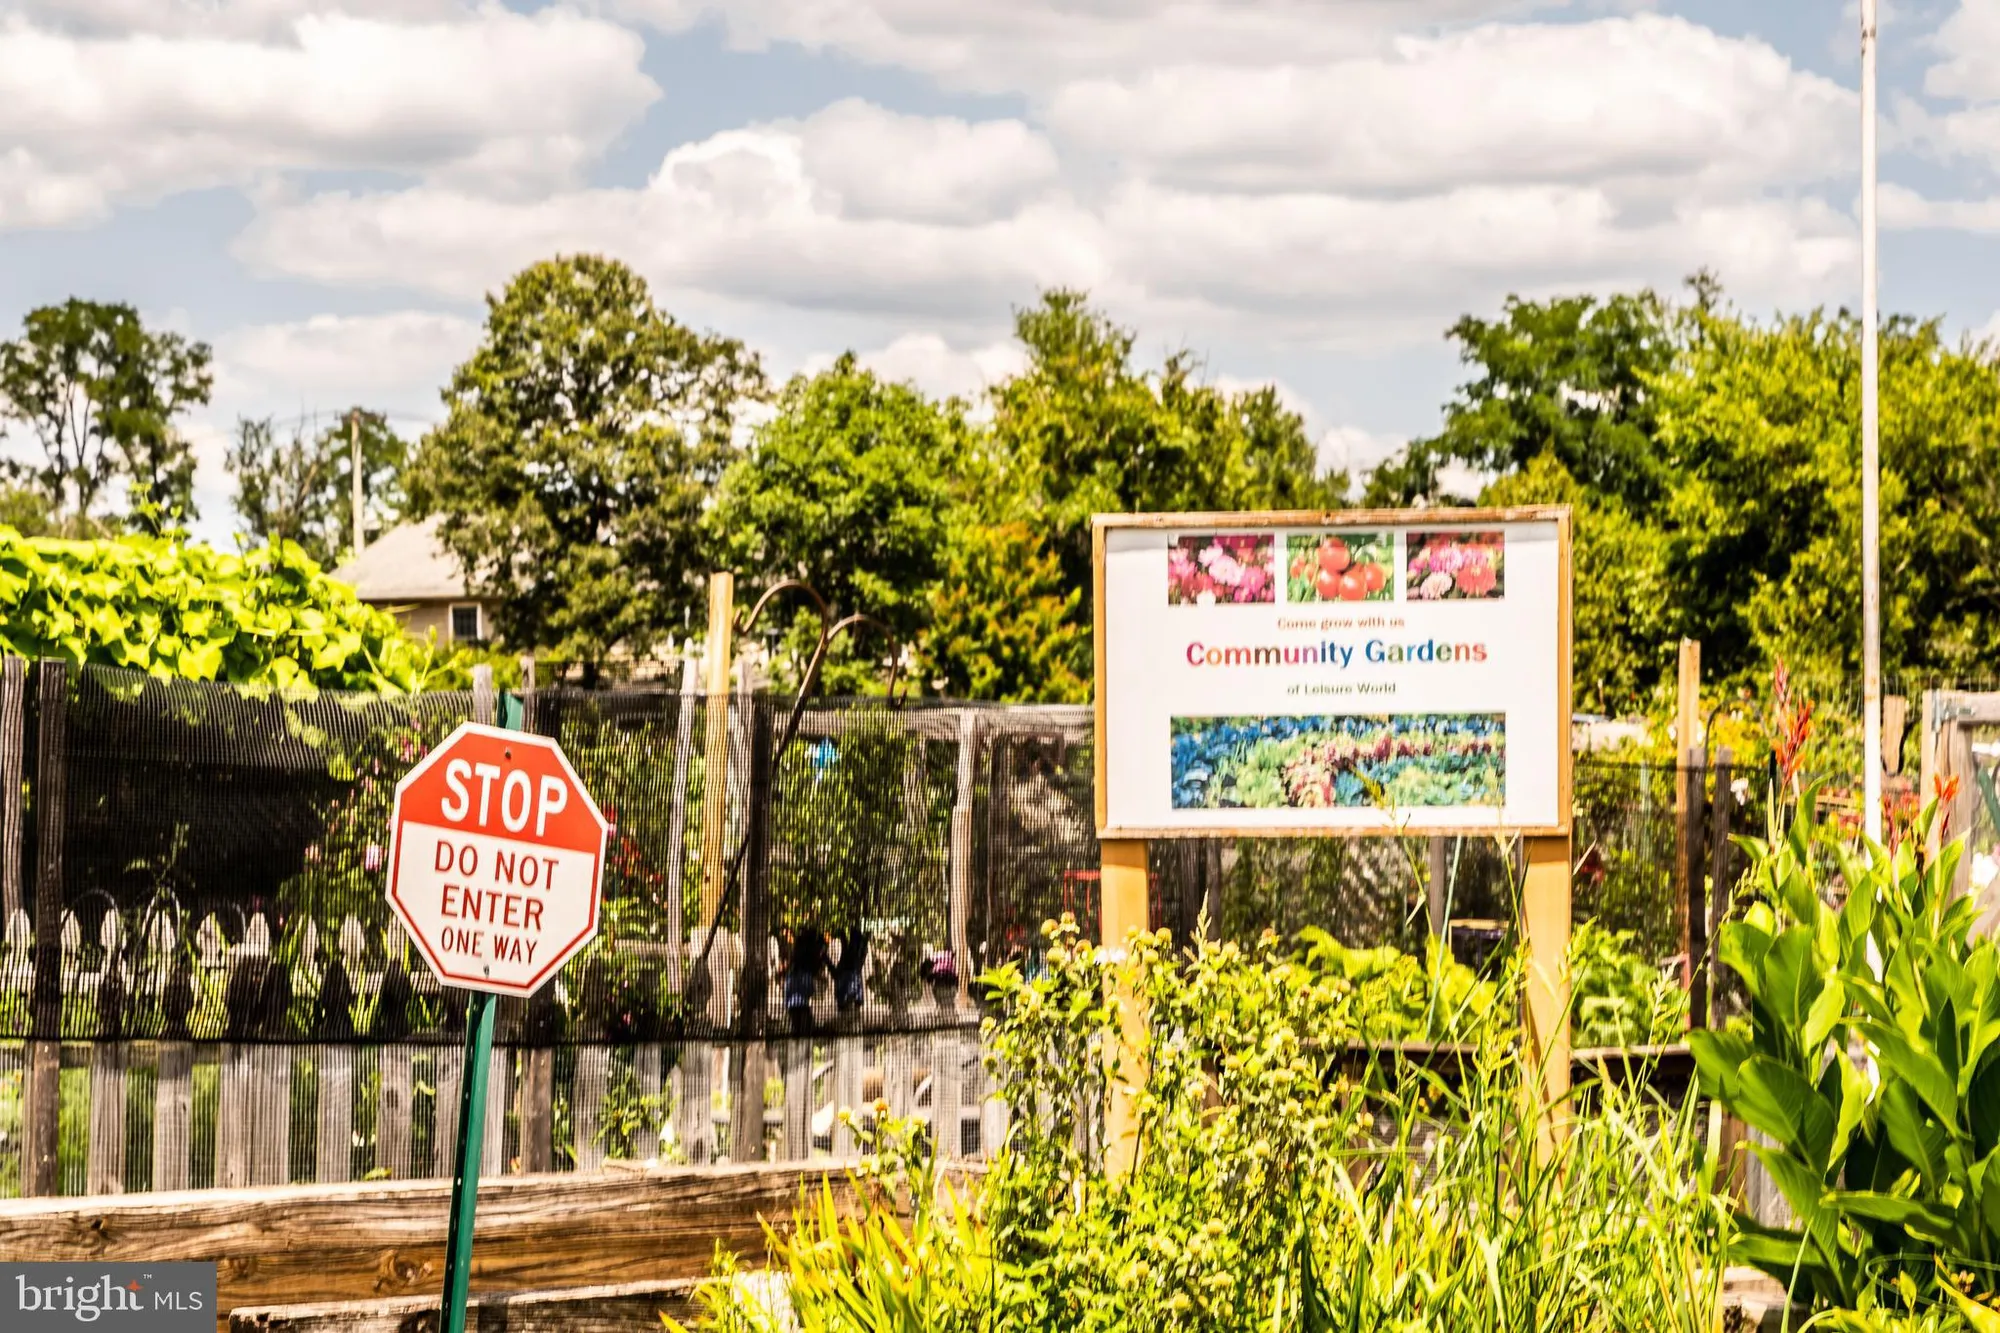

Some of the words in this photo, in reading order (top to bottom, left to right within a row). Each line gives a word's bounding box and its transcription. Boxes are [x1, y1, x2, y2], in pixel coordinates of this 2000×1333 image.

[1277, 617, 1316, 630] Come
[1321, 617, 1352, 632] grow
[1358, 616, 1385, 628] with
[1390, 617, 1405, 628] us
[1186, 640, 1353, 669] Community
[1365, 639, 1488, 663] Gardens
[1287, 684, 1300, 695] of
[1304, 683, 1352, 695] Leisure
[1358, 682, 1396, 695] World
[441, 758, 568, 837] STOP
[434, 840, 478, 877] DO
[494, 850, 559, 890] NOT
[440, 884, 544, 931] ENTER
[441, 927, 484, 958] ONE
[493, 934, 538, 965] WAY
